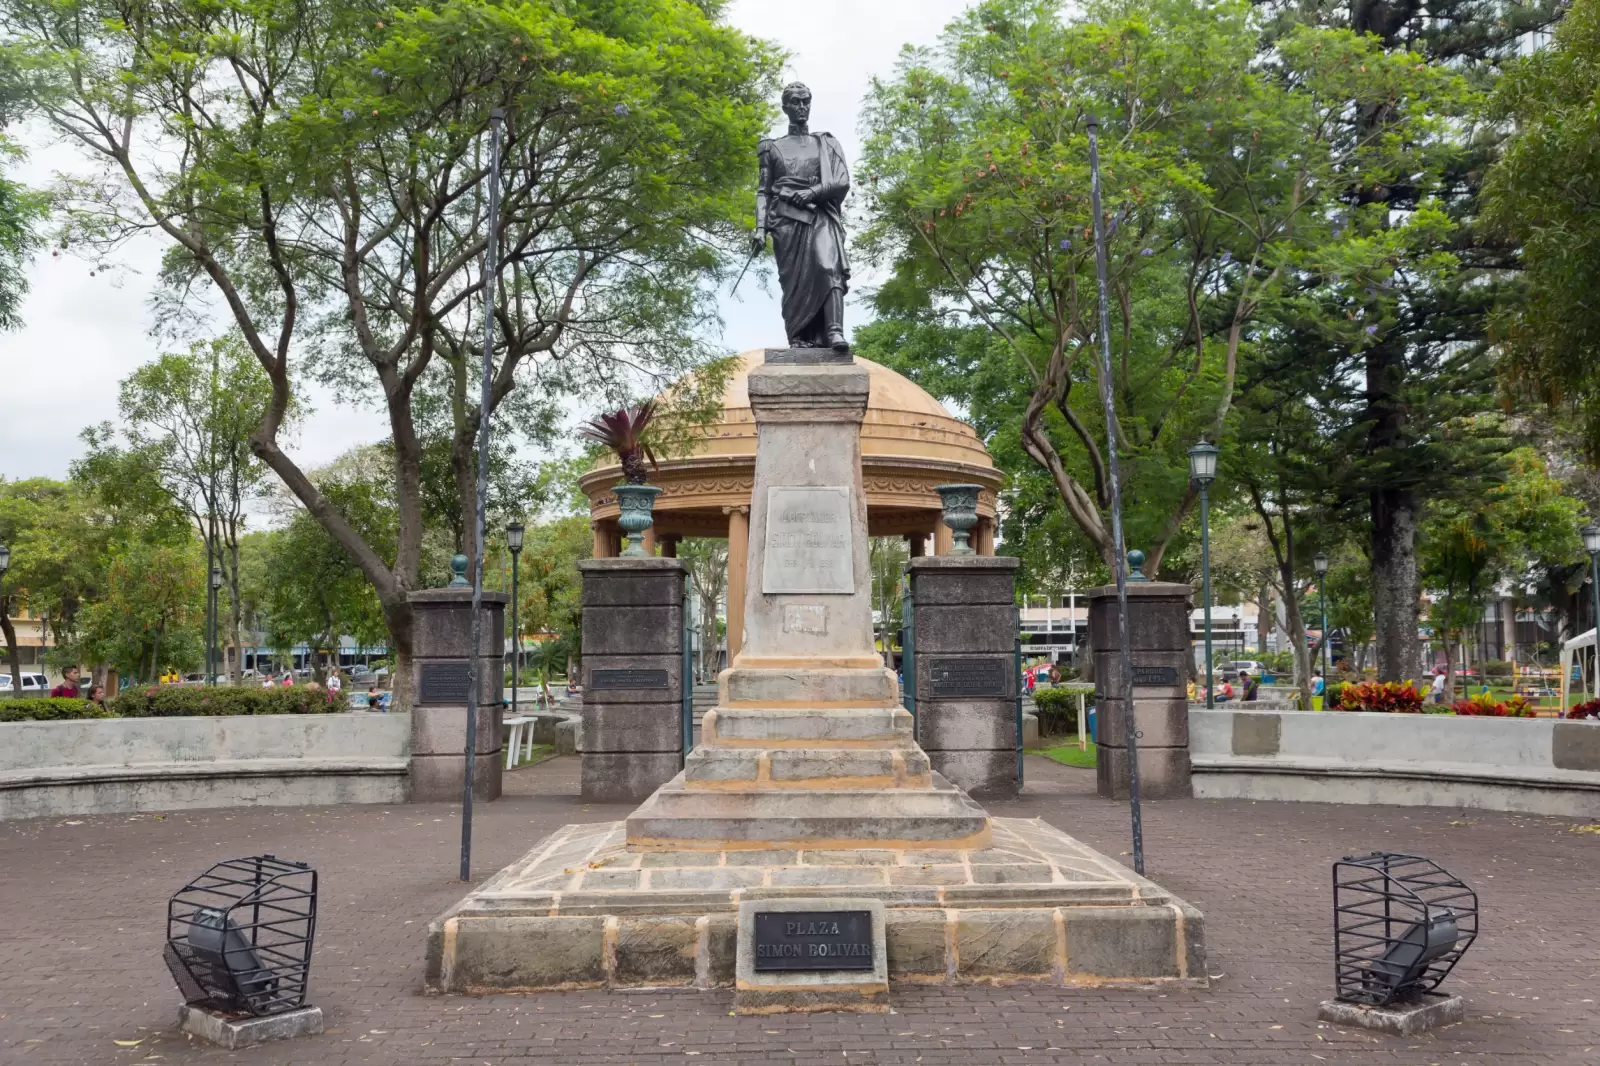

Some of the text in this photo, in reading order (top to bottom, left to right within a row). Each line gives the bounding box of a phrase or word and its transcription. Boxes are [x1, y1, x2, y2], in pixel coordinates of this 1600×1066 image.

[785, 921, 841, 935] PLAZA
[756, 943, 871, 958] SIMON BOLIVAR
